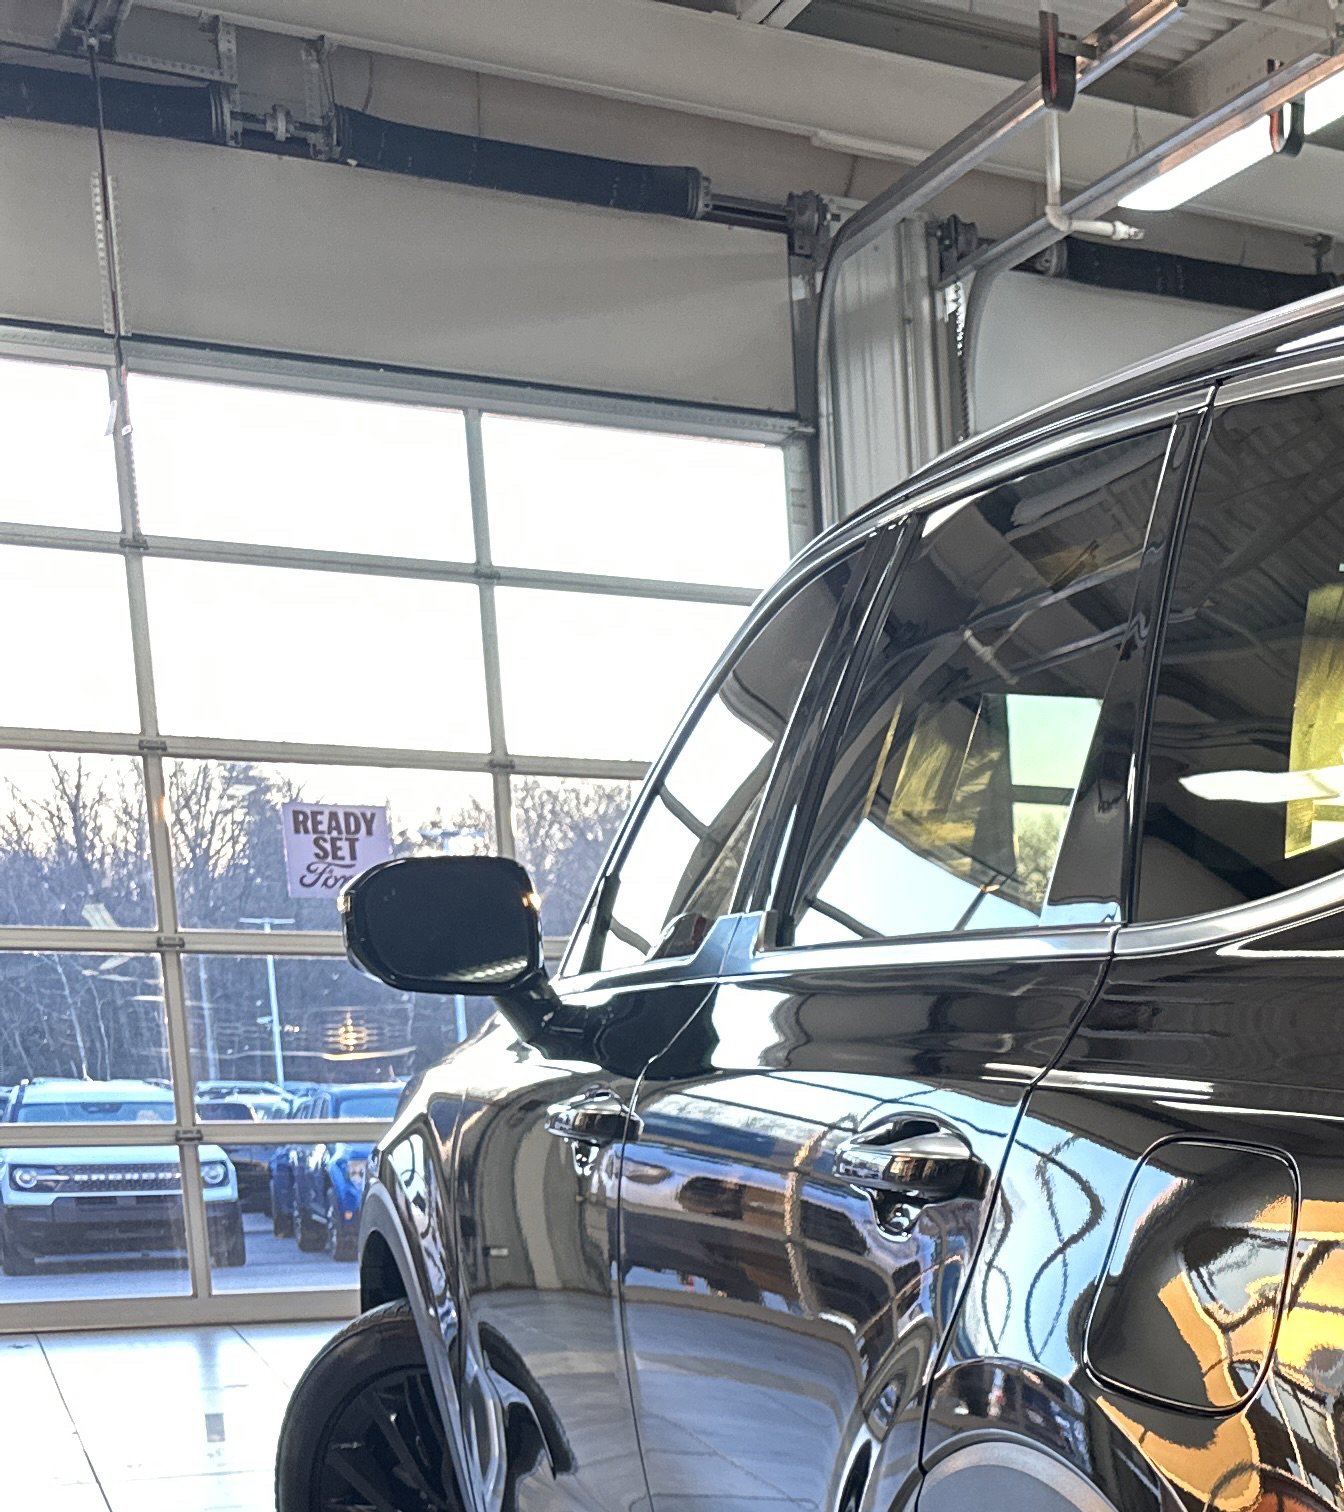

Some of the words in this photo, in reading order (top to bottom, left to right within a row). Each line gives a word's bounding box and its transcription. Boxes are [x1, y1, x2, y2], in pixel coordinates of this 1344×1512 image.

[292, 810, 376, 837] READY
[313, 836, 359, 861] SET
[300, 861, 356, 889] For
